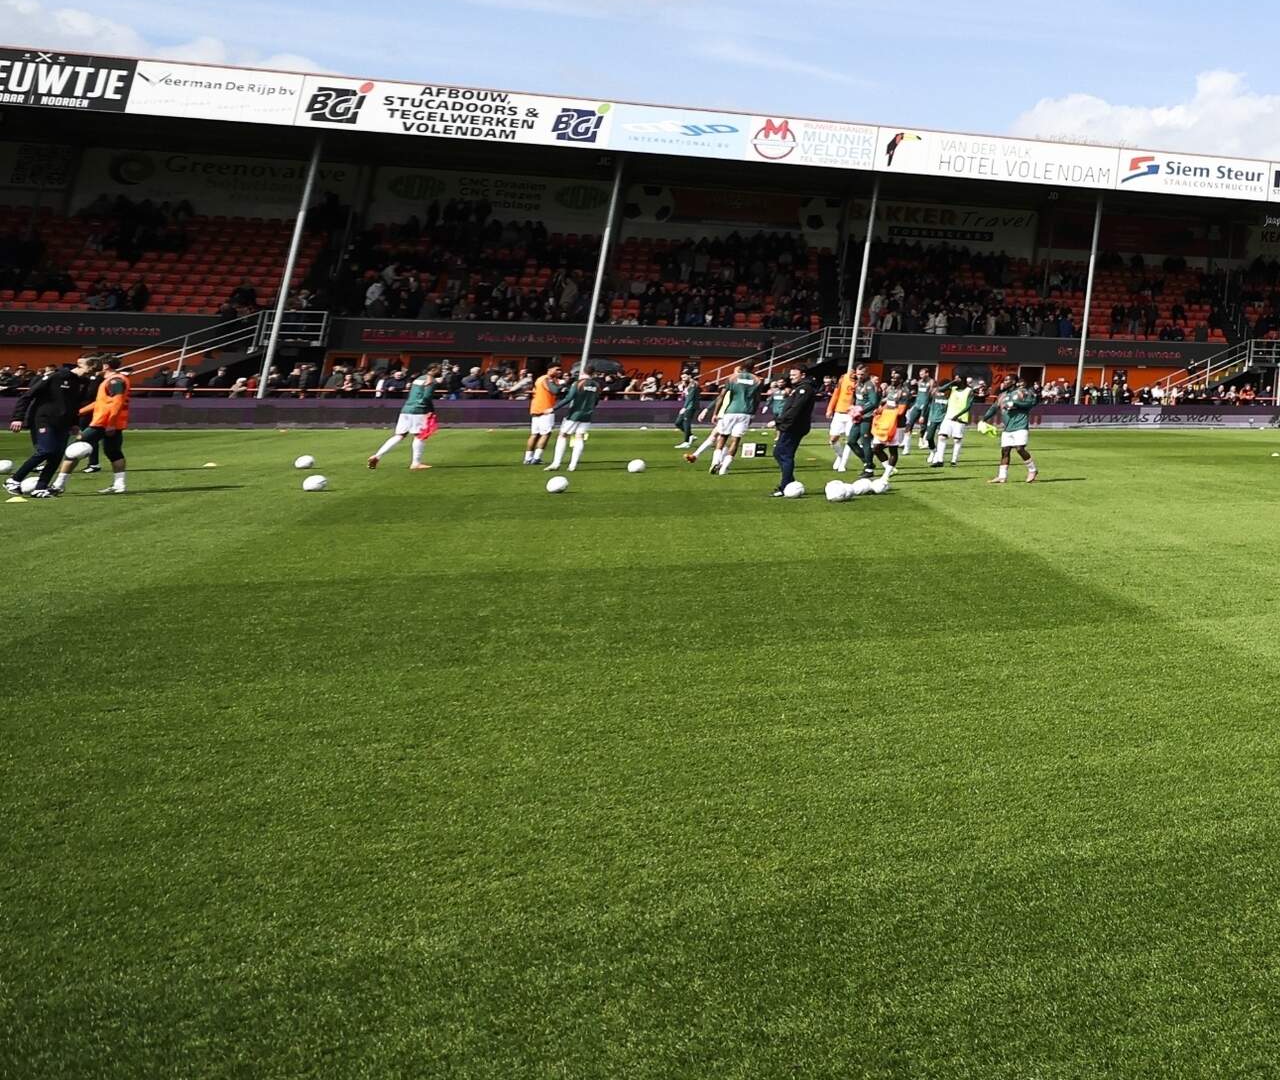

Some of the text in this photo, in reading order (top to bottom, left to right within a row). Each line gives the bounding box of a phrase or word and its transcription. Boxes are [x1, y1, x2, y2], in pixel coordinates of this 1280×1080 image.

[137, 72, 222, 91] Veerman
[248, 83, 276, 97] Rijp
[278, 86, 297, 96] bv
[41, 96, 90, 108] NOORDEN
[420, 86, 511, 106] AFBOUW,
[383, 95, 540, 119] STUCADOORS &
[387, 108, 535, 130] TEGELWERKEN
[402, 121, 517, 141] VOLENDAM
[801, 130, 874, 148] MUNNIK
[801, 143, 873, 159] VELDER
[939, 138, 1033, 160] VAN DER VALK
[938, 153, 1112, 185] HOTEL VOLENDAM
[1165, 161, 1265, 183] Siem Steur
[459, 177, 489, 189] CNC
[1163, 177, 1264, 193] STAALCONSTRUCTIES
[459, 187, 490, 198] CNC
[495, 189, 542, 201] Frezen
